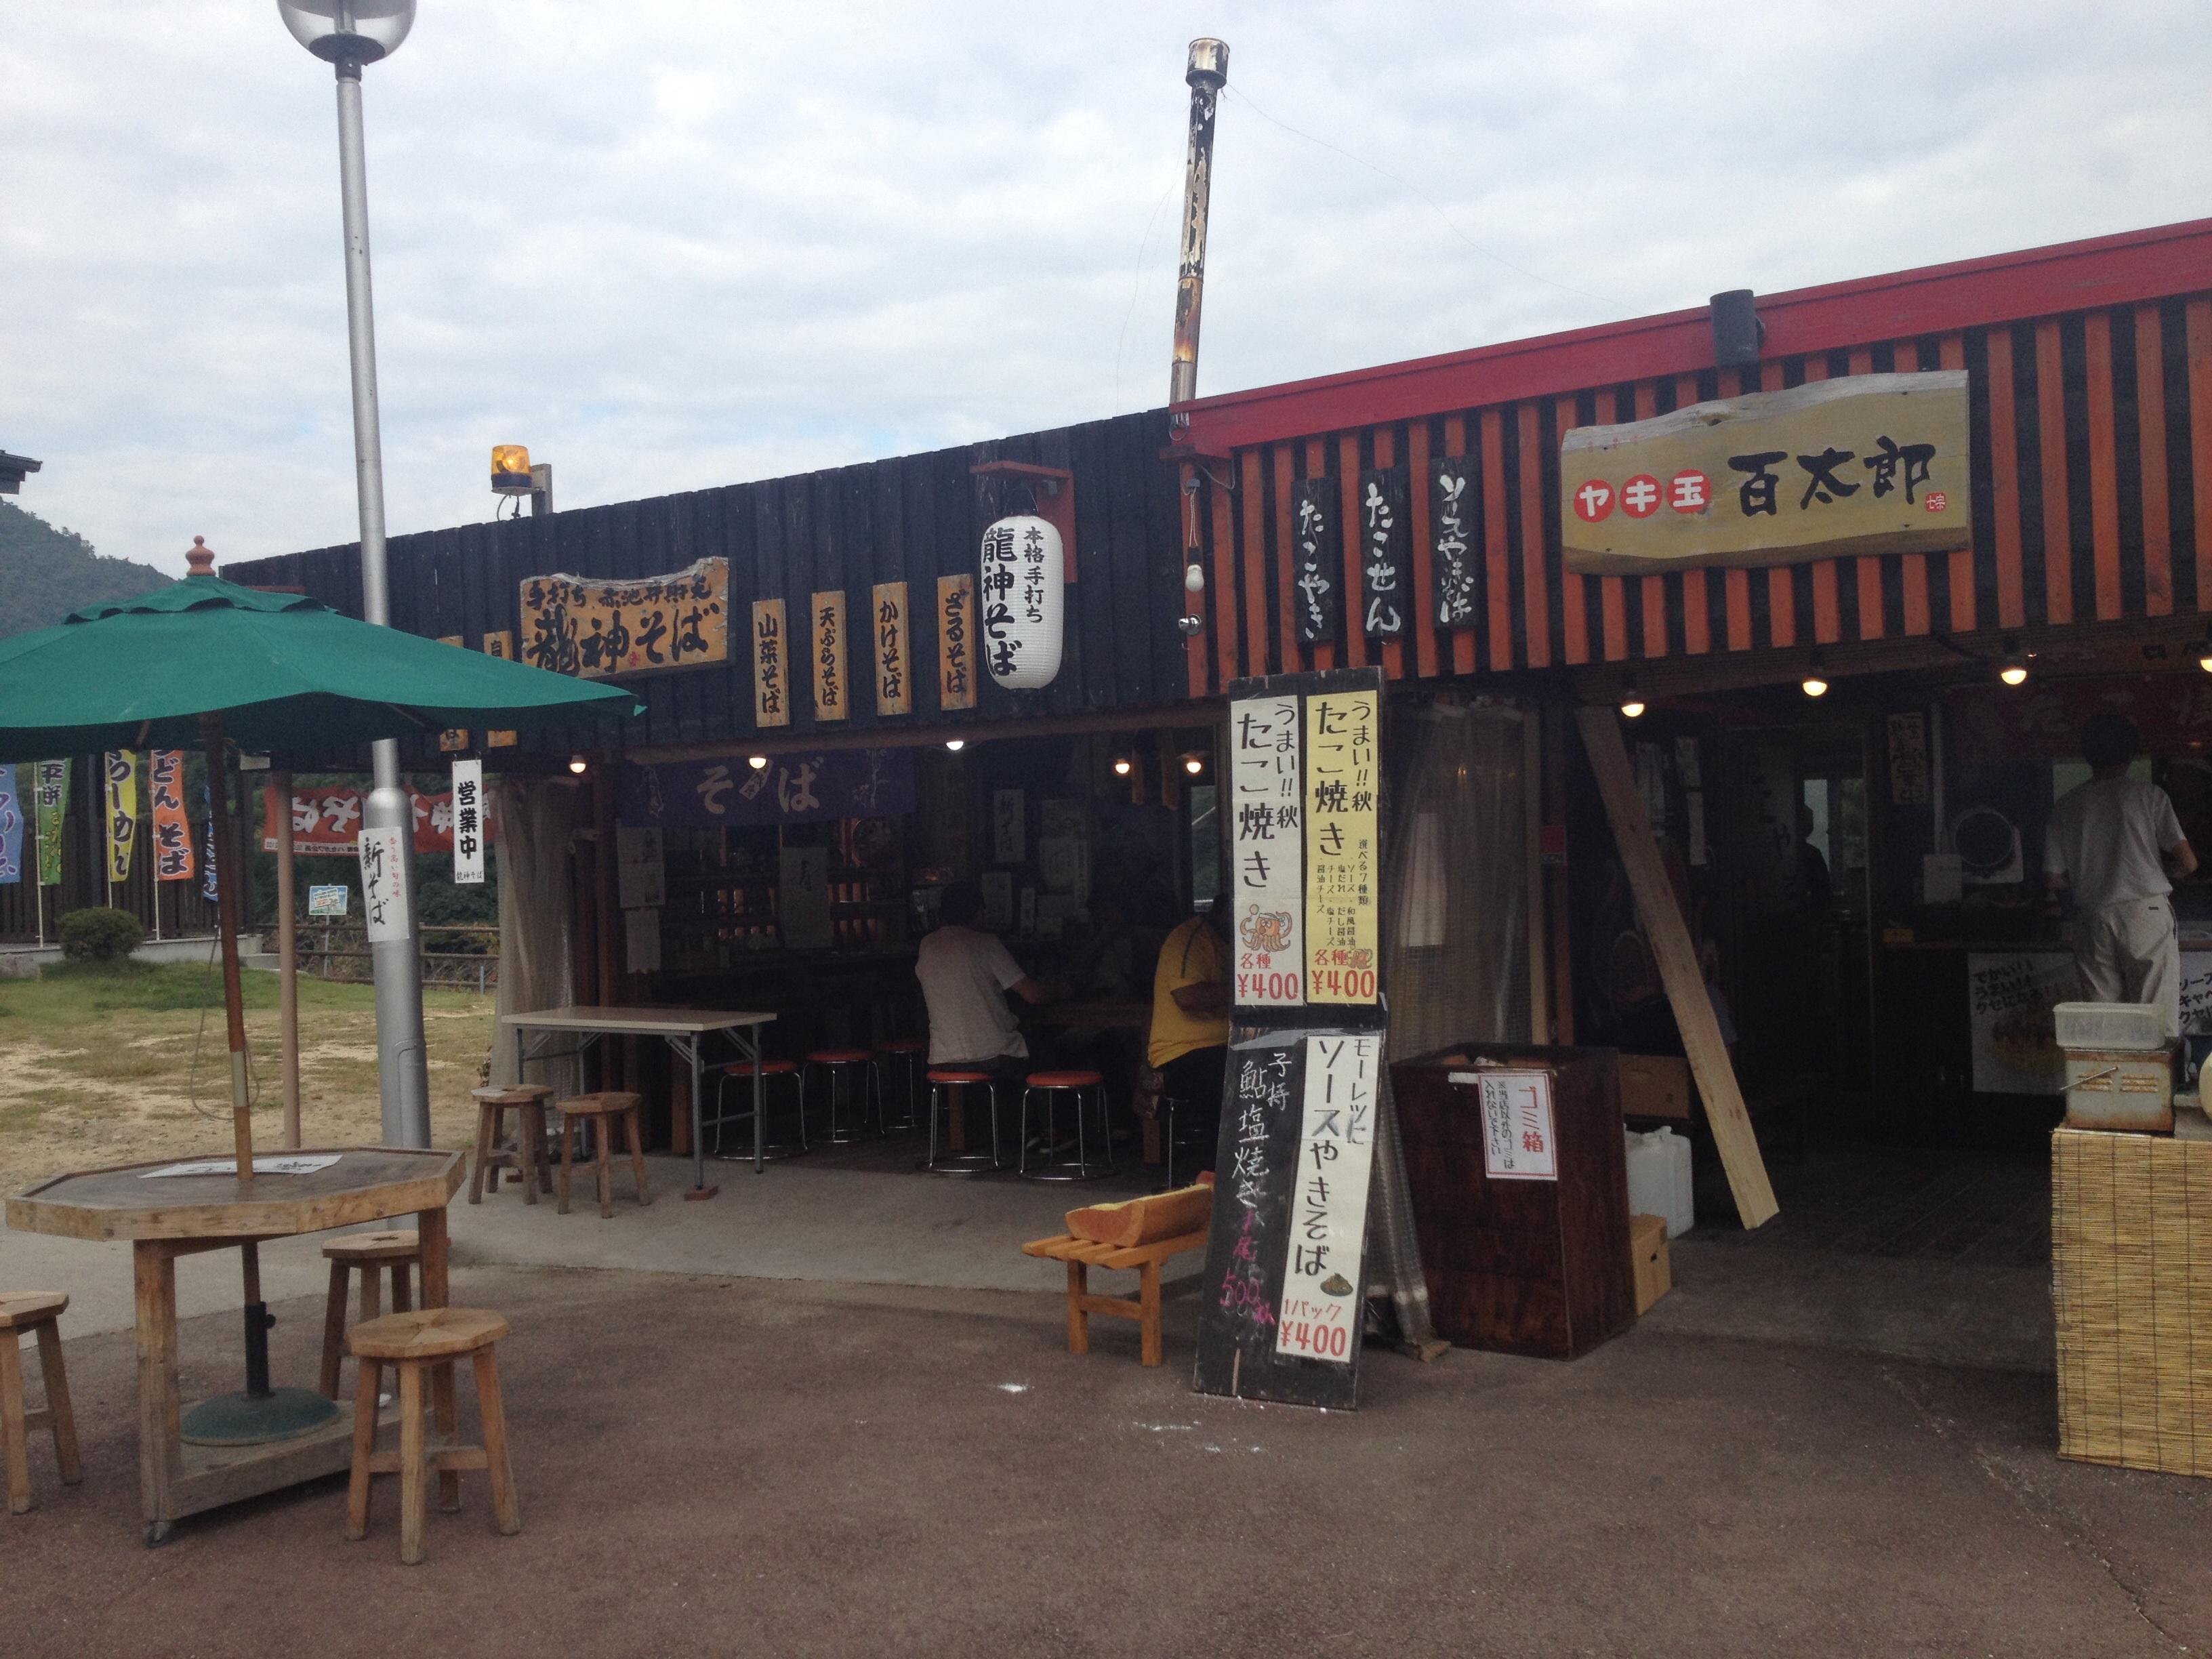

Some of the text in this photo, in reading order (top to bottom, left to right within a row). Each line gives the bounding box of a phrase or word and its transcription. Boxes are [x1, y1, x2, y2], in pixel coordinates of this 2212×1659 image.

[1579, 435, 1937, 517] ヤキ玉 百太郎
[526, 579, 587, 610] 手打ち
[1023, 525, 1046, 624] 本格手打ち
[1298, 499, 1330, 638] たこやき
[1365, 483, 1401, 633] たこせん
[526, 602, 720, 678] 龍神そば
[945, 588, 970, 695] ざるそば
[983, 526, 1023, 678] 龍神そば
[758, 613, 781, 715] 山菜そば
[819, 606, 839, 708] 天ぷらそば
[879, 600, 902, 699] かけそば
[41, 759, 66, 806] 平餅
[697, 757, 825, 814] そば
[1237, 713, 1275, 888] たこ焼き
[1315, 701, 1348, 856] たこ焼き
[159, 822, 190, 876] そば
[457, 780, 478, 860] 営業中
[363, 836, 390, 926] 新そば
[1237, 972, 1298, 1000] ¥400
[1240, 953, 1272, 969] 各種
[1312, 970, 1375, 998] ¥400
[1315, 949, 1349, 966] 各種
[1266, 1052, 1292, 1111] 子持
[1519, 1086, 1544, 1153] ゴミ箱
[1231, 1060, 1270, 1208] 鮎塩焼き
[1294, 1040, 1345, 1277] ソースやきそば
[1280, 1319, 1347, 1356] ¥400
